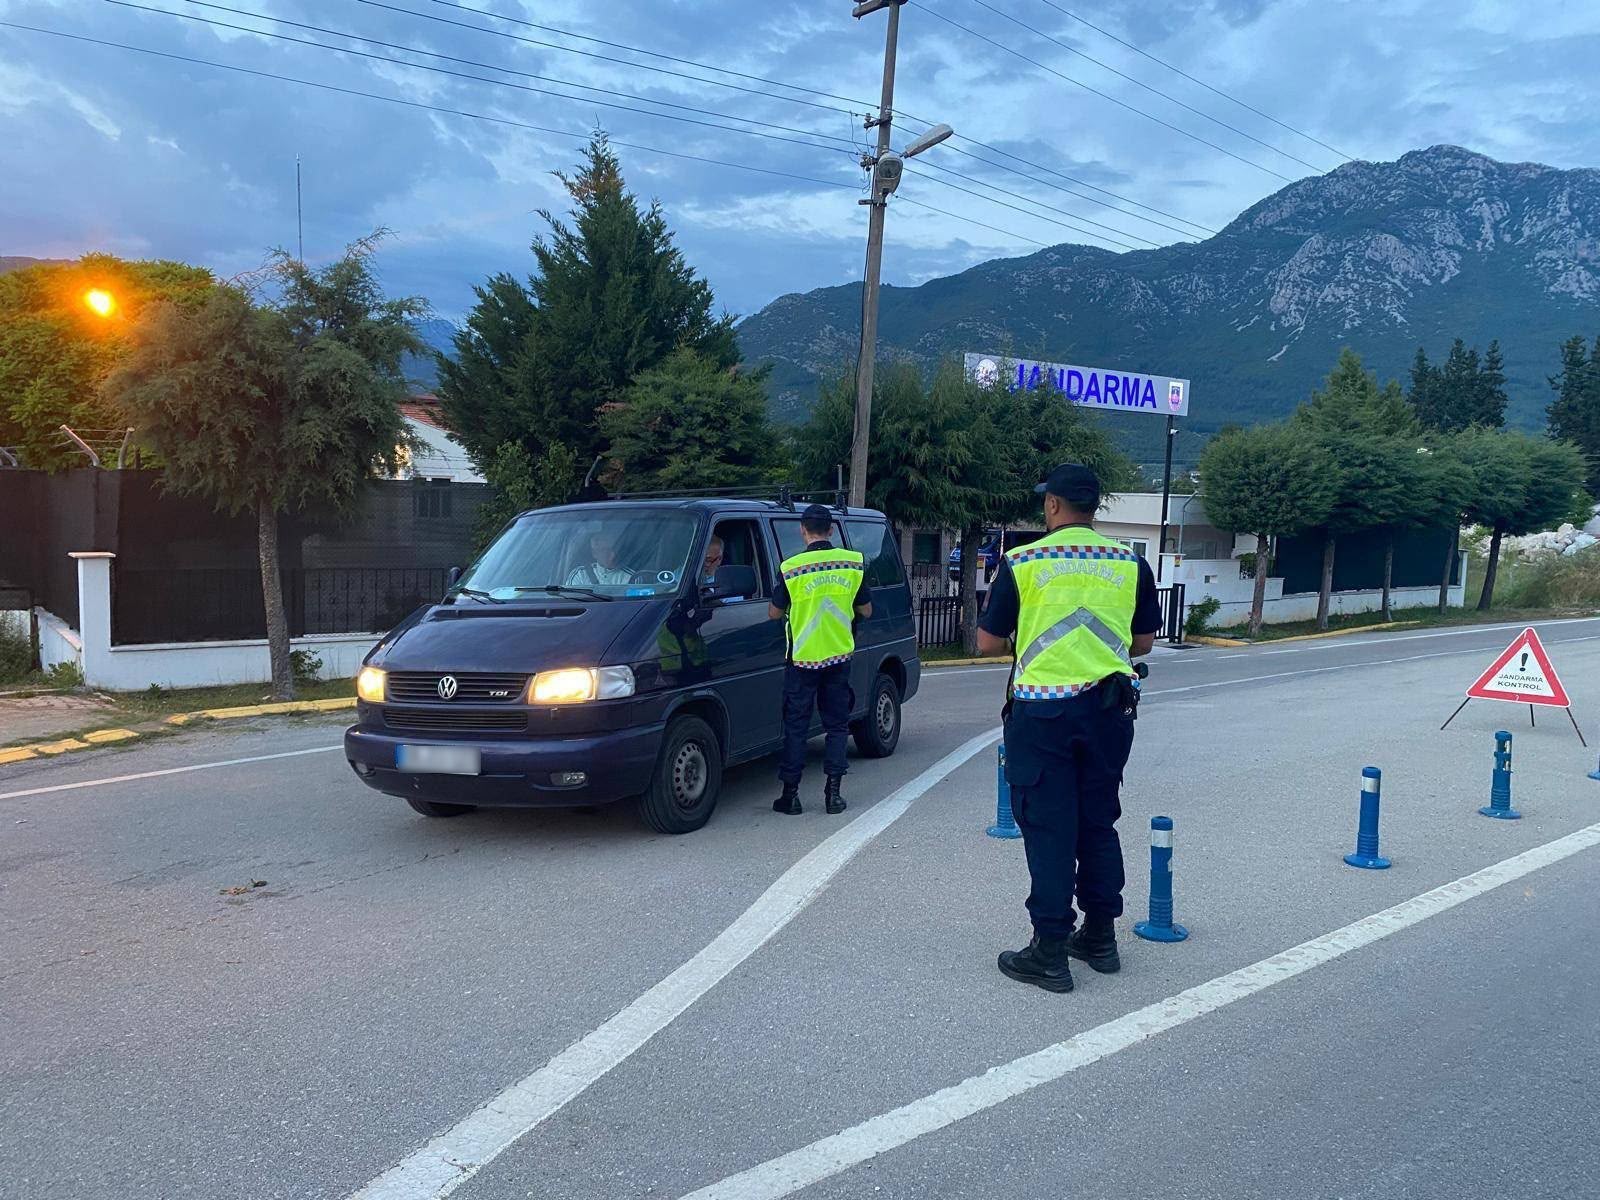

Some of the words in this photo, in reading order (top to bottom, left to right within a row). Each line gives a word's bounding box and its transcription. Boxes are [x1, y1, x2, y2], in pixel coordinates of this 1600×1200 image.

[1035, 560, 1125, 589] JANDARMA
[1498, 673, 1544, 683] JANDARMA
[1497, 681, 1542, 691] KONTROL
